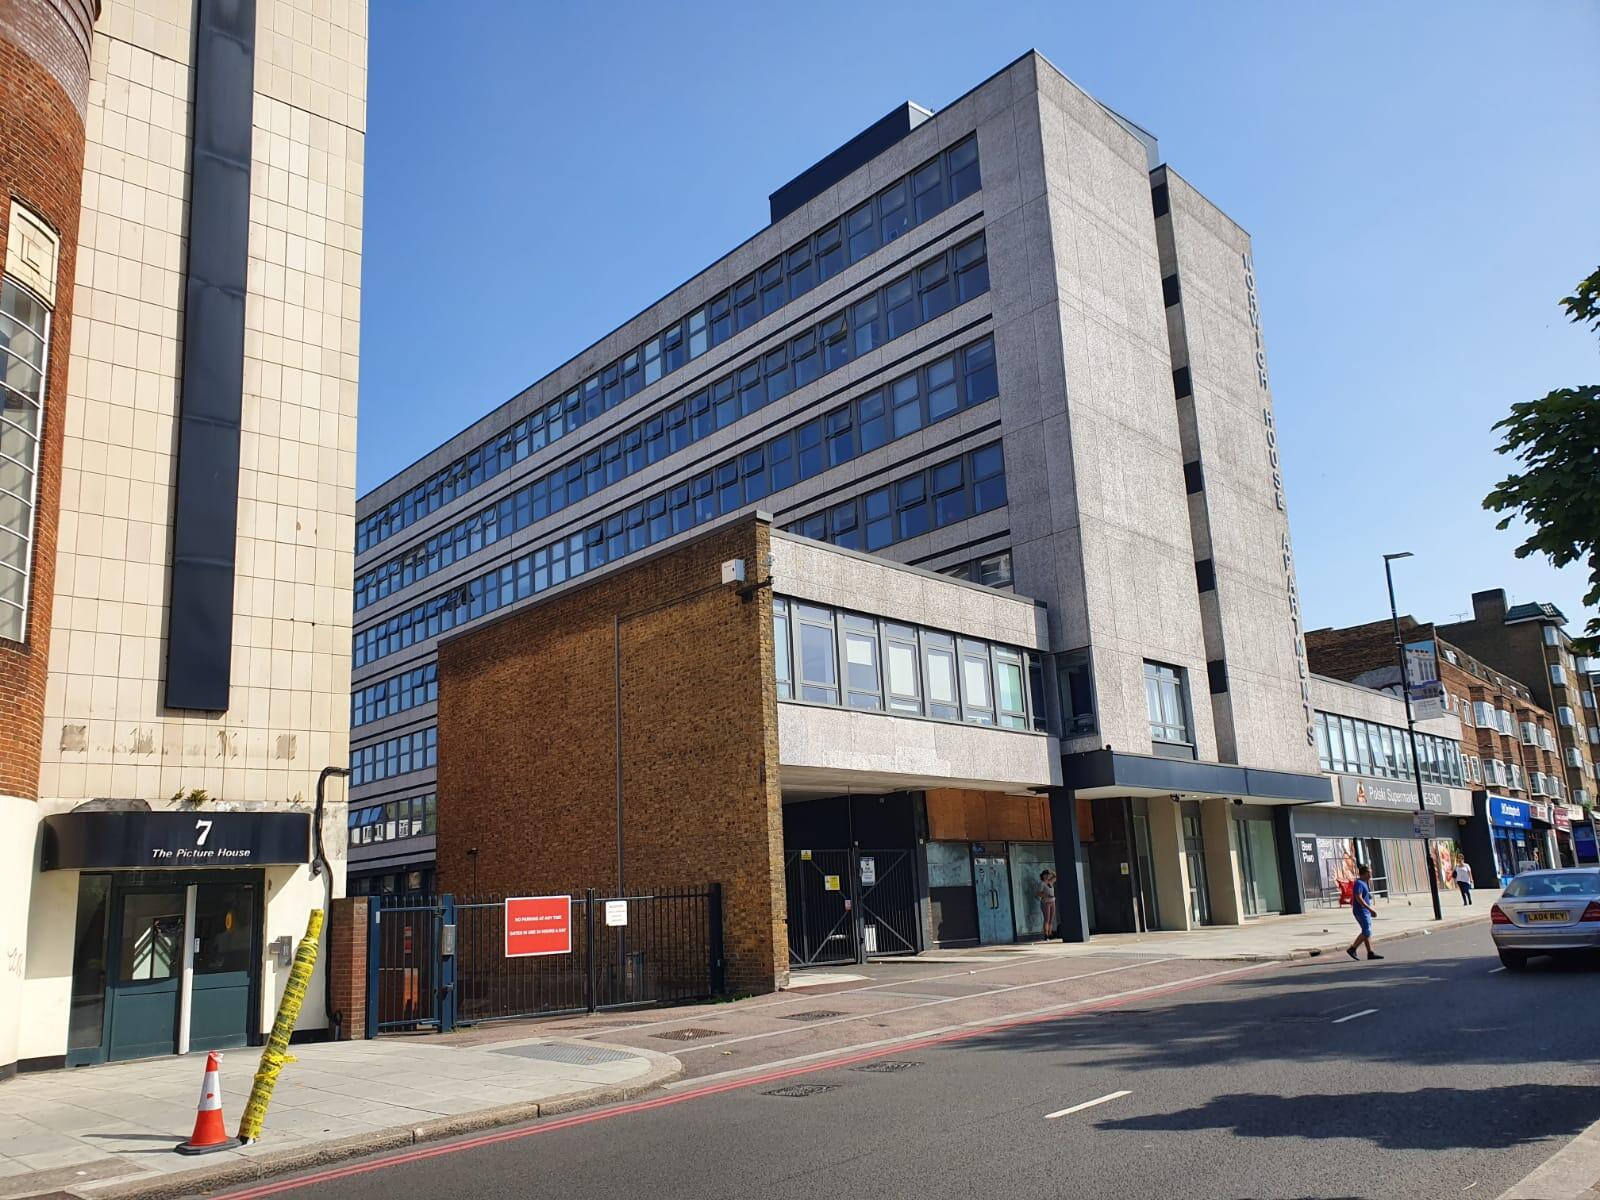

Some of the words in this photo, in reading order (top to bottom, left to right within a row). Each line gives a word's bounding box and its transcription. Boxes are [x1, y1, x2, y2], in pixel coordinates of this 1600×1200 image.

[1241, 252, 1269, 391] NORWICH
[1263, 408, 1284, 512] HOUSE
[1281, 532, 1316, 747] APARTMENTS
[1369, 785, 1386, 801] Polski
[1386, 787, 1419, 805] Supermarke
[195, 819, 213, 846] 7
[152, 848, 173, 858] The
[176, 848, 215, 858] Picture
[217, 847, 251, 857] House
